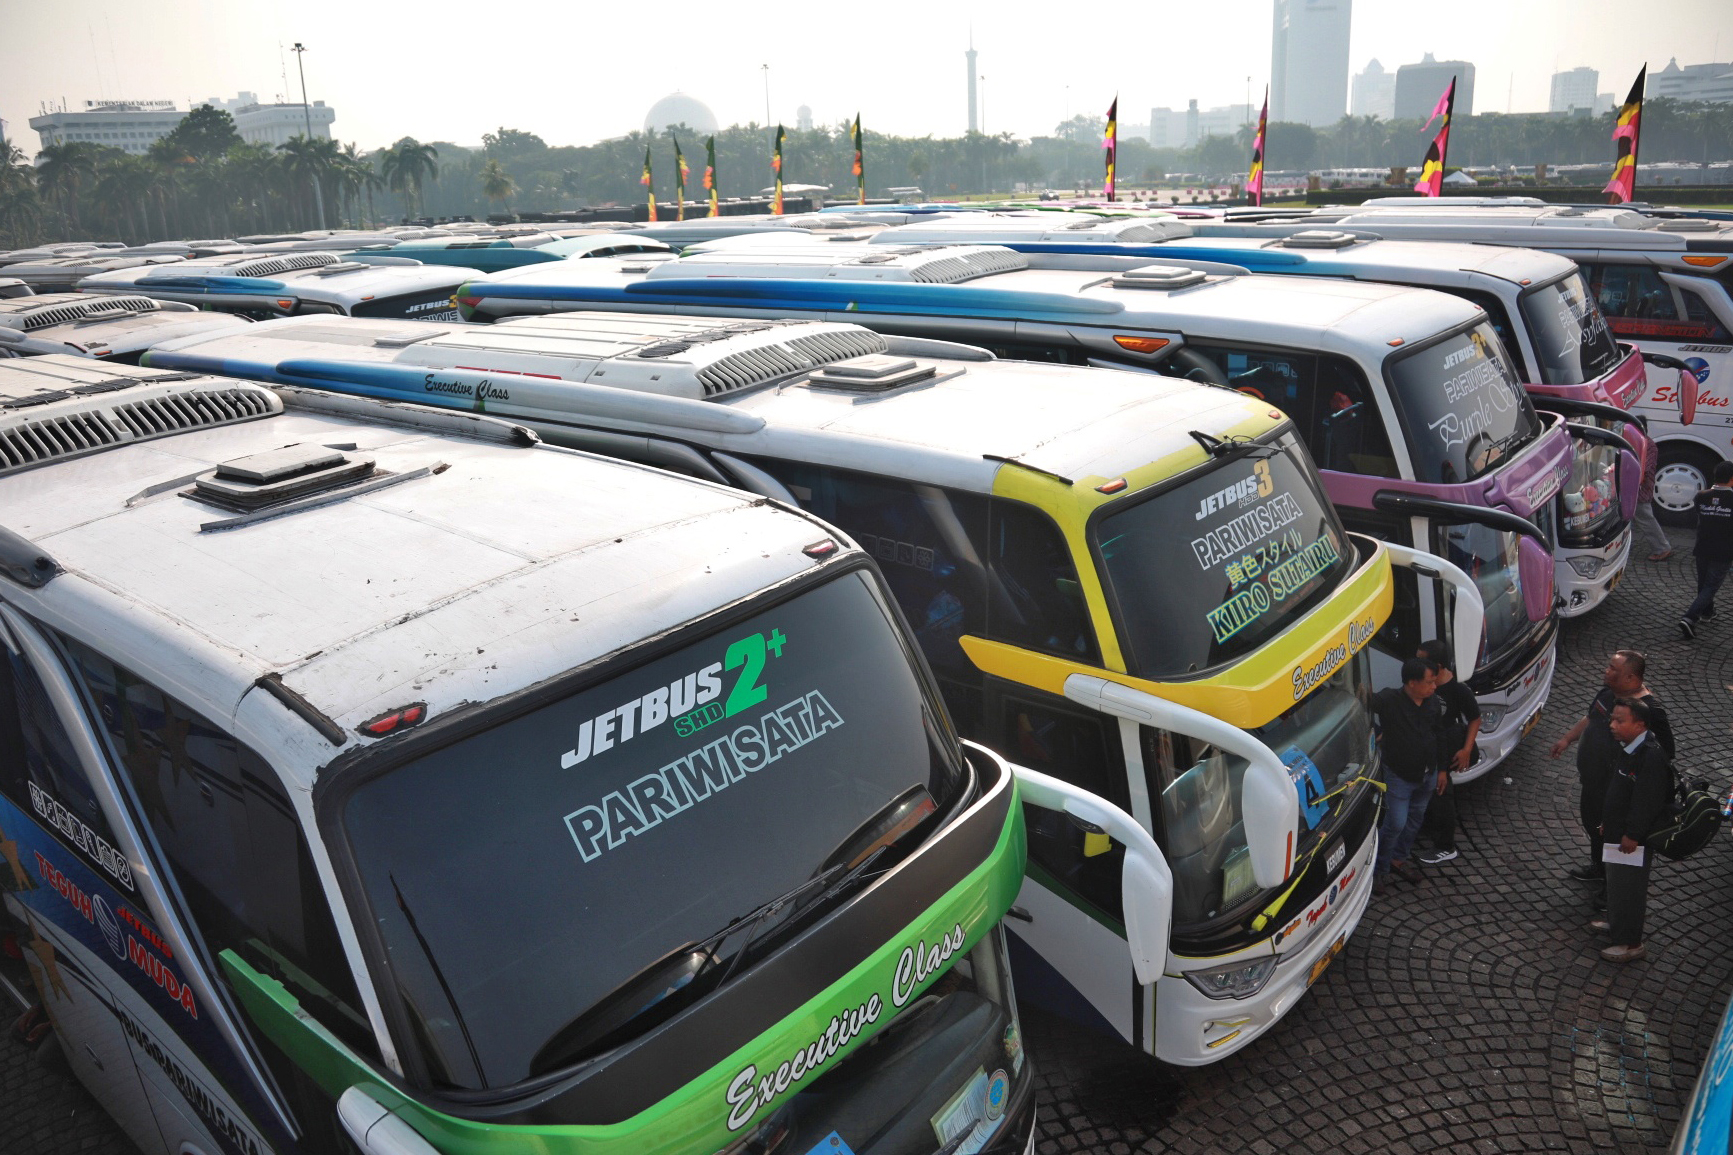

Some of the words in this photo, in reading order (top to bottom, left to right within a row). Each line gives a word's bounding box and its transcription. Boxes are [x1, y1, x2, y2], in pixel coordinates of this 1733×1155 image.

[405, 299, 450, 313] JETBUS
[1443, 344, 1475, 370] JETBUS
[1677, 344, 1733, 354] JETBUS
[425, 373, 473, 396] Executive
[476, 379, 509, 400] Class
[1195, 474, 1258, 521] JETBUS
[1253, 458, 1274, 498] 3
[1190, 491, 1304, 571] PARIWISATA
[1224, 528, 1303, 591] 黄色スタイル
[1206, 581, 1271, 646] KIIRO
[1267, 532, 1340, 602] SUTAIRU
[1291, 643, 1347, 701] Executive
[1348, 616, 1375, 656] Class
[560, 660, 723, 770] JETBUS
[673, 701, 725, 738] SHD
[562, 689, 845, 863] PARIWISATA
[33, 849, 95, 925] TEGUH
[128, 934, 198, 1020] MUDA
[117, 904, 174, 960] JETBUS
[726, 992, 884, 1132] Executive
[891, 922, 967, 1008] Class
